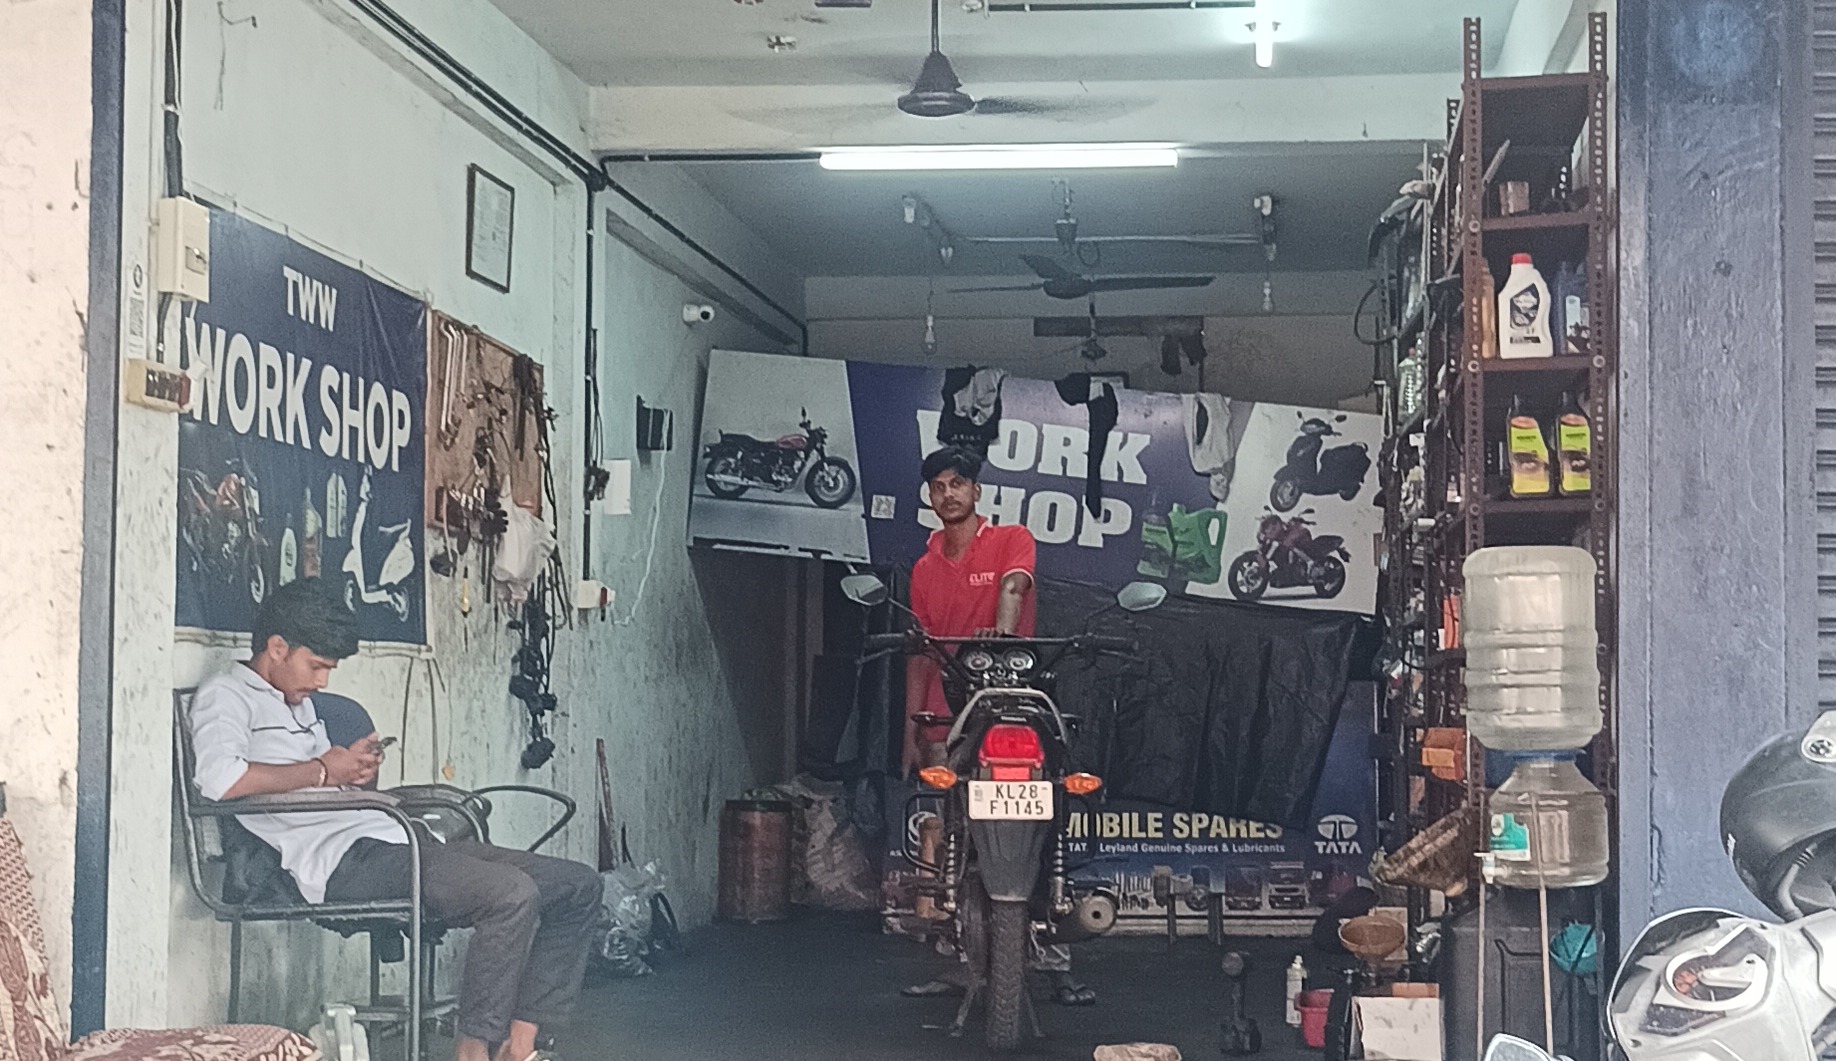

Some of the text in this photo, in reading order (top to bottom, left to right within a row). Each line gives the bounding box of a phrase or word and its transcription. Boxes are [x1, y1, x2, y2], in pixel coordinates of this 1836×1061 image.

[283, 265, 337, 332] TWW
[186, 316, 411, 473] WORK SHOP
[995, 784, 1039, 799] KL28
[990, 800, 1044, 815] F1145
[1172, 812, 1283, 839] SPARES
[1100, 842, 1138, 854] Leyland
[1141, 842, 1182, 852] Genuine
[1185, 843, 1219, 855] Spares
[1221, 843, 1230, 853] &
[1232, 843, 1286, 853] Lubricants
[1314, 841, 1363, 854] TATA
